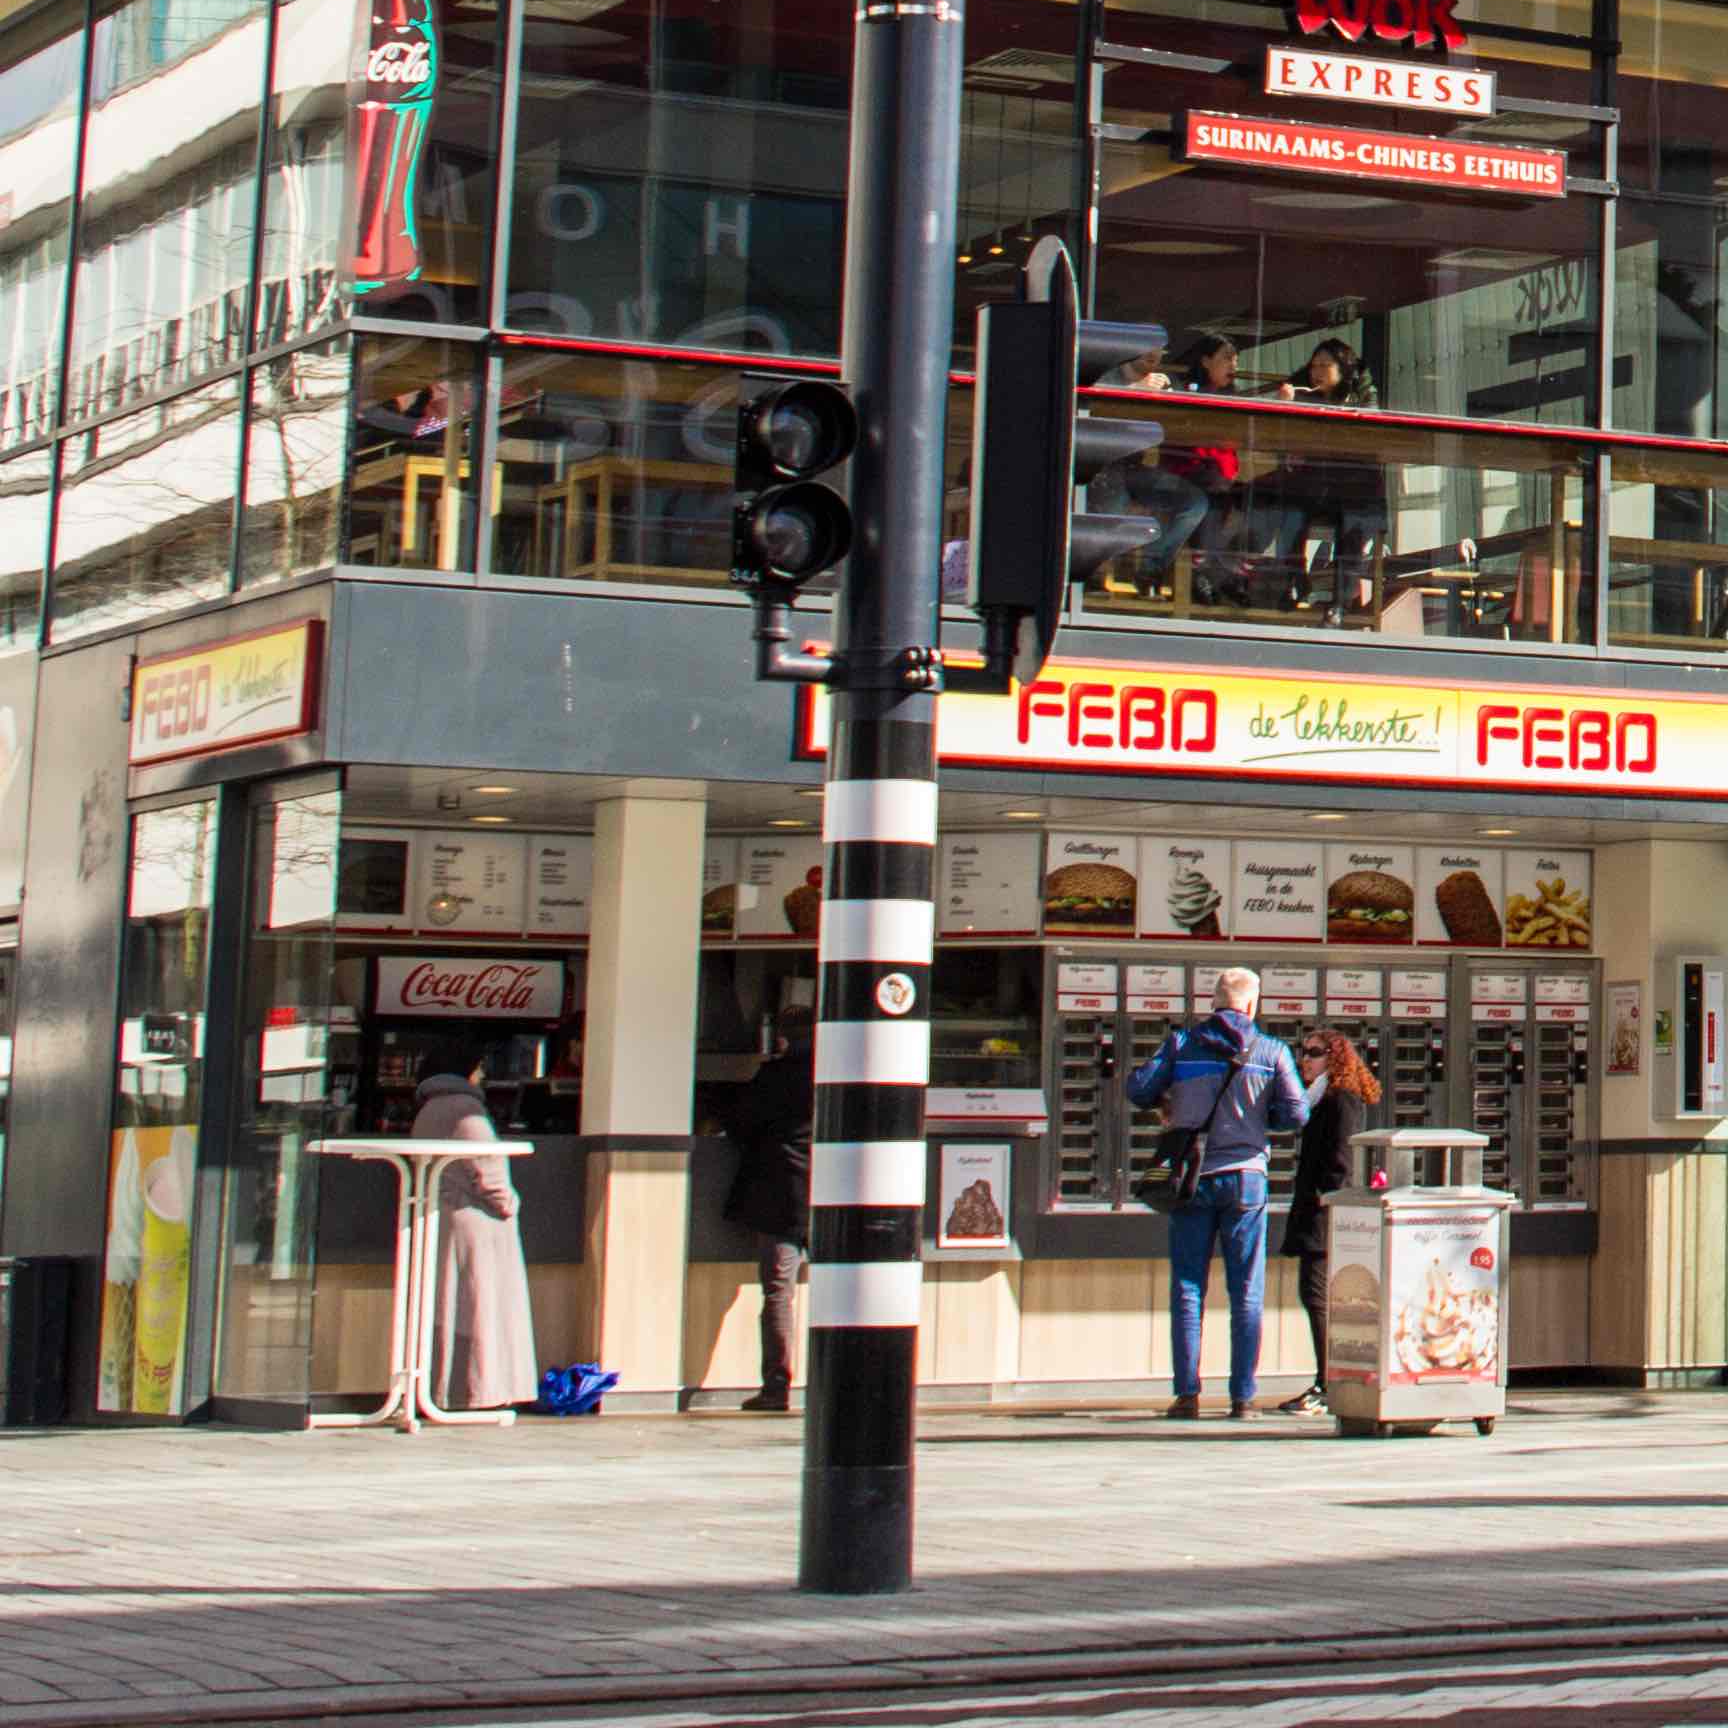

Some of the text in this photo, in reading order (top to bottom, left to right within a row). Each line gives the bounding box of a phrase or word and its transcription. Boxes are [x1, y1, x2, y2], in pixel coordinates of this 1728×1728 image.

[367, 41, 432, 83] Cola
[1280, 57, 1483, 106] EXPRESS
[1195, 124, 1558, 185] SURINAAMS-CHINEES EETHUIS
[141, 664, 211, 744] FEBO
[1017, 681, 1217, 752] FEBO
[1250, 702, 1279, 738] de
[1477, 705, 1657, 773] FEBO
[1243, 900, 1273, 913] FEBO
[401, 962, 543, 1010] Coca-Cola
